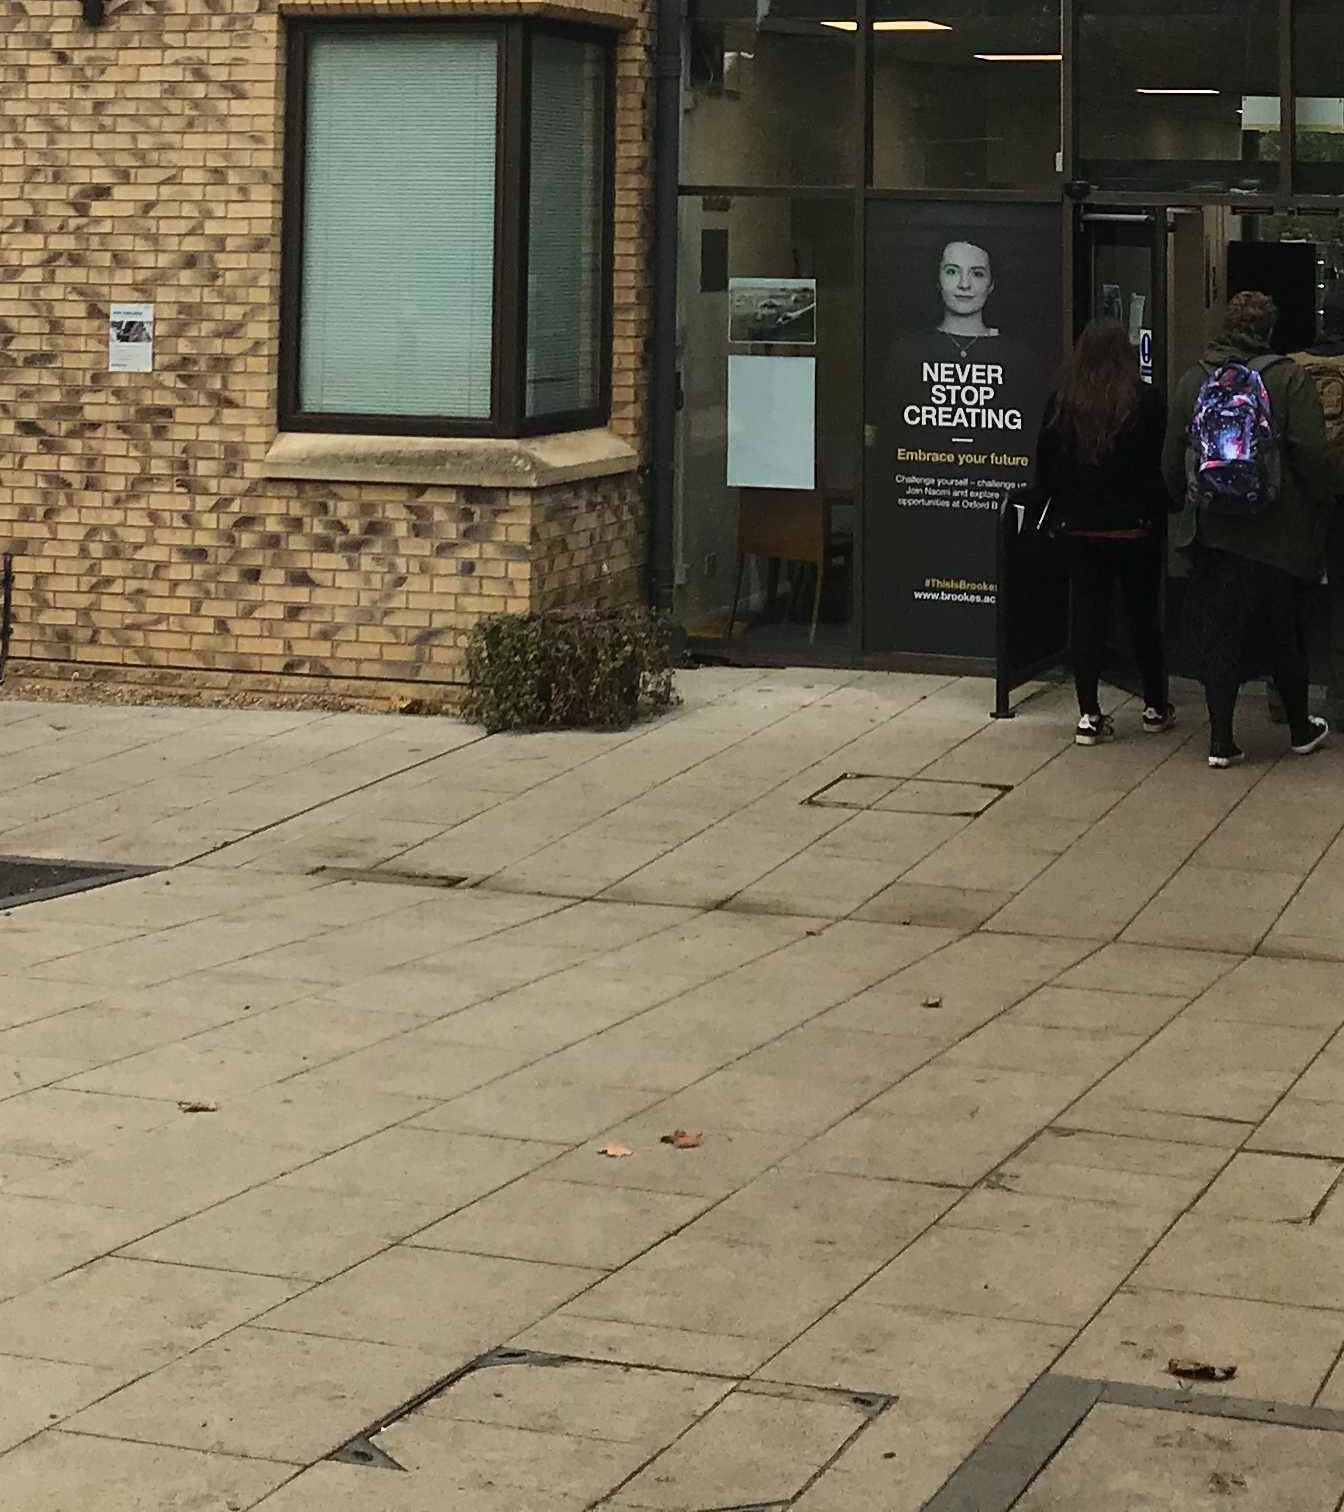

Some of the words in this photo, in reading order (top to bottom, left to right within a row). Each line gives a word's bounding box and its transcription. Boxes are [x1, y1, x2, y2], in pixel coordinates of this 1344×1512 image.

[922, 362, 1004, 385] NEVER
[930, 384, 995, 406] STOP
[903, 405, 1022, 430] CREATING
[897, 448, 955, 463] Embrace
[958, 454, 987, 466] your
[990, 453, 1029, 467] future
[895, 474, 935, 486] Challenge
[937, 477, 968, 487] yourself
[906, 486, 923, 495] Join
[924, 486, 950, 496] Naomi
[952, 489, 968, 497] and
[969, 490, 1000, 499] explore
[897, 497, 950, 508] opportunities
[952, 500, 960, 508] at
[961, 499, 990, 509] Oxford
[913, 591, 997, 604] www.brookes.ac
